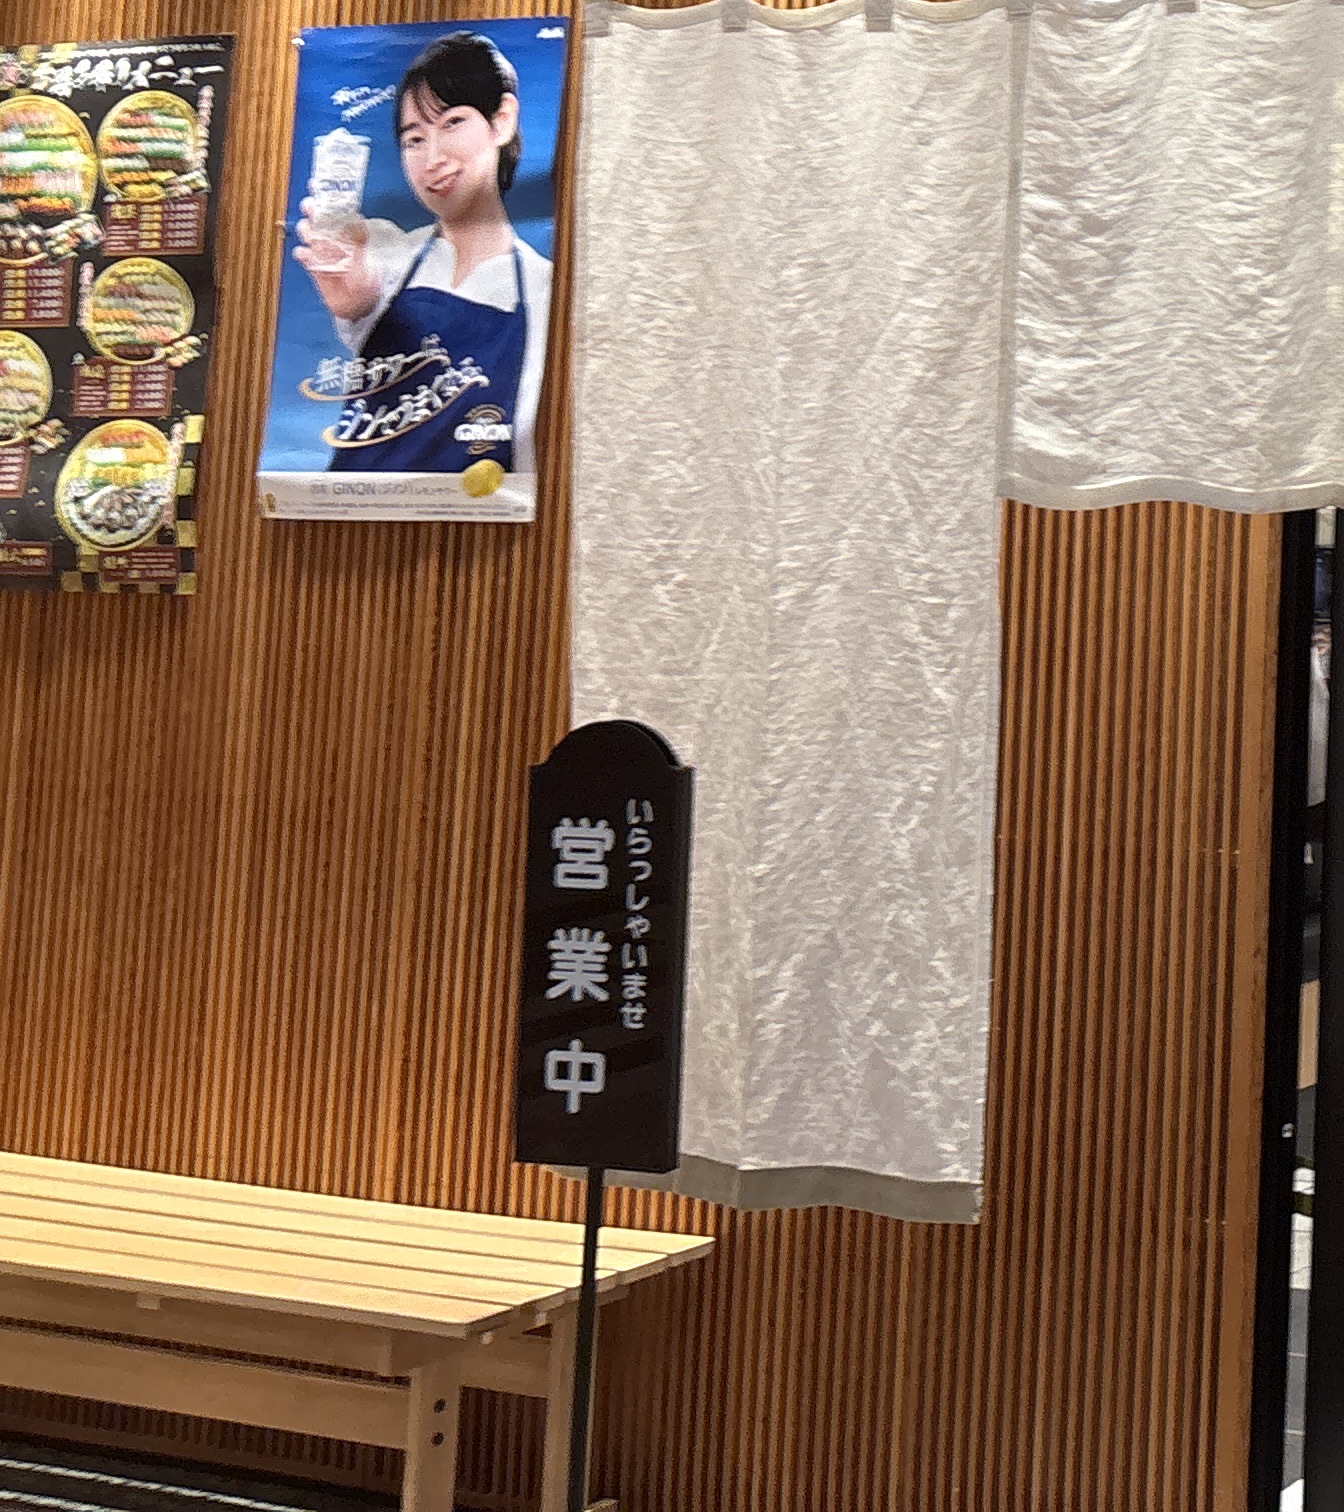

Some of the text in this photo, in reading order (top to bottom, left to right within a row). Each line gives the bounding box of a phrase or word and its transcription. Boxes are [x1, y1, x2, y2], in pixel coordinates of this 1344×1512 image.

[544, 816, 616, 1115] 営業中
[618, 797, 655, 1030] いらっしゃいませ
